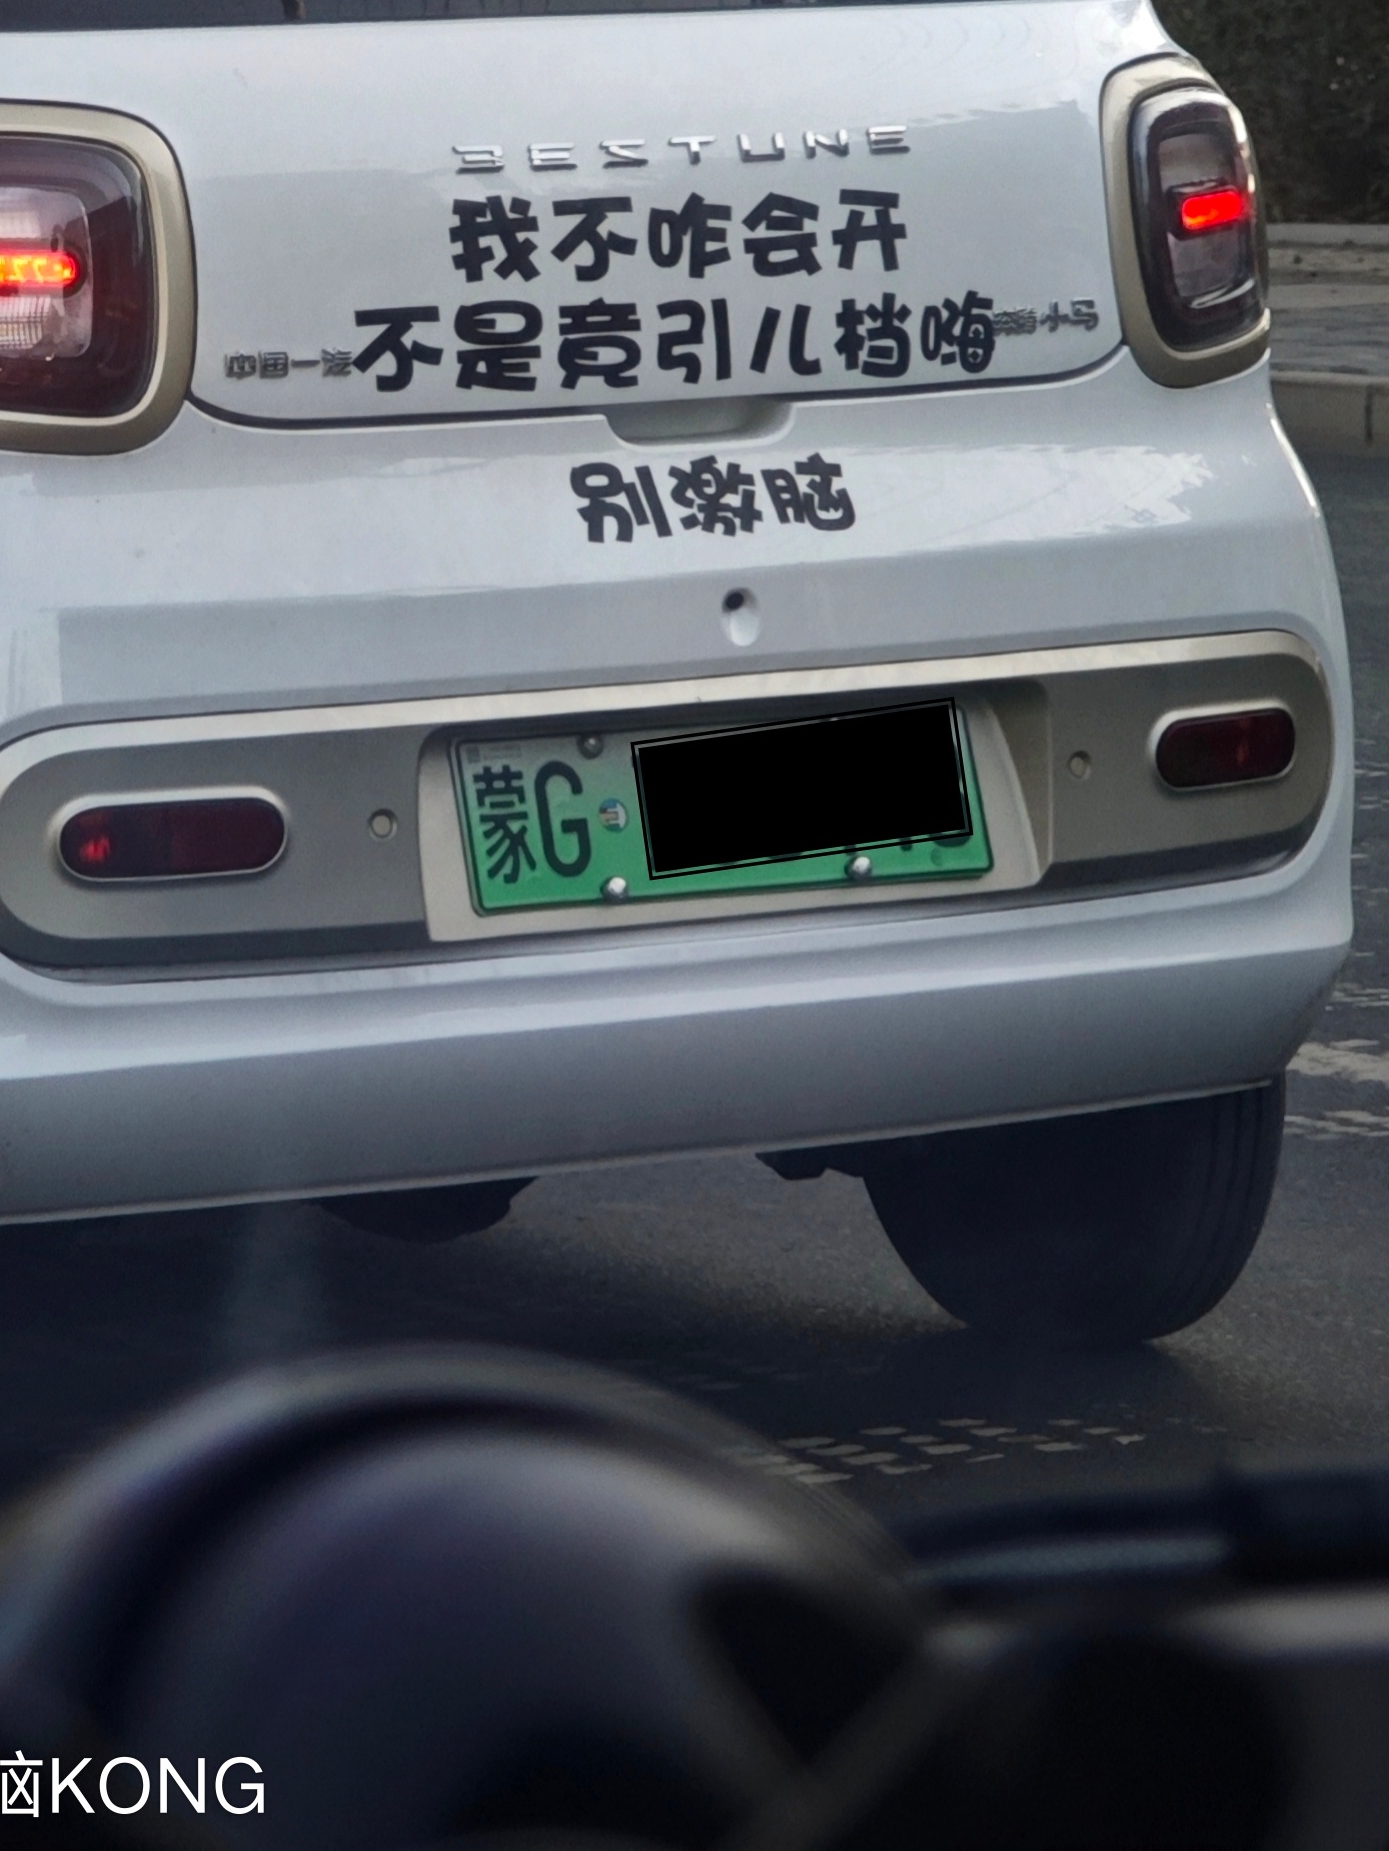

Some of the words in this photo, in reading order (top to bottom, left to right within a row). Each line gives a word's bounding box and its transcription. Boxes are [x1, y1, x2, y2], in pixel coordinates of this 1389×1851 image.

[453, 125, 911, 174] BESTUNE
[449, 188, 908, 284] 我不咋会开
